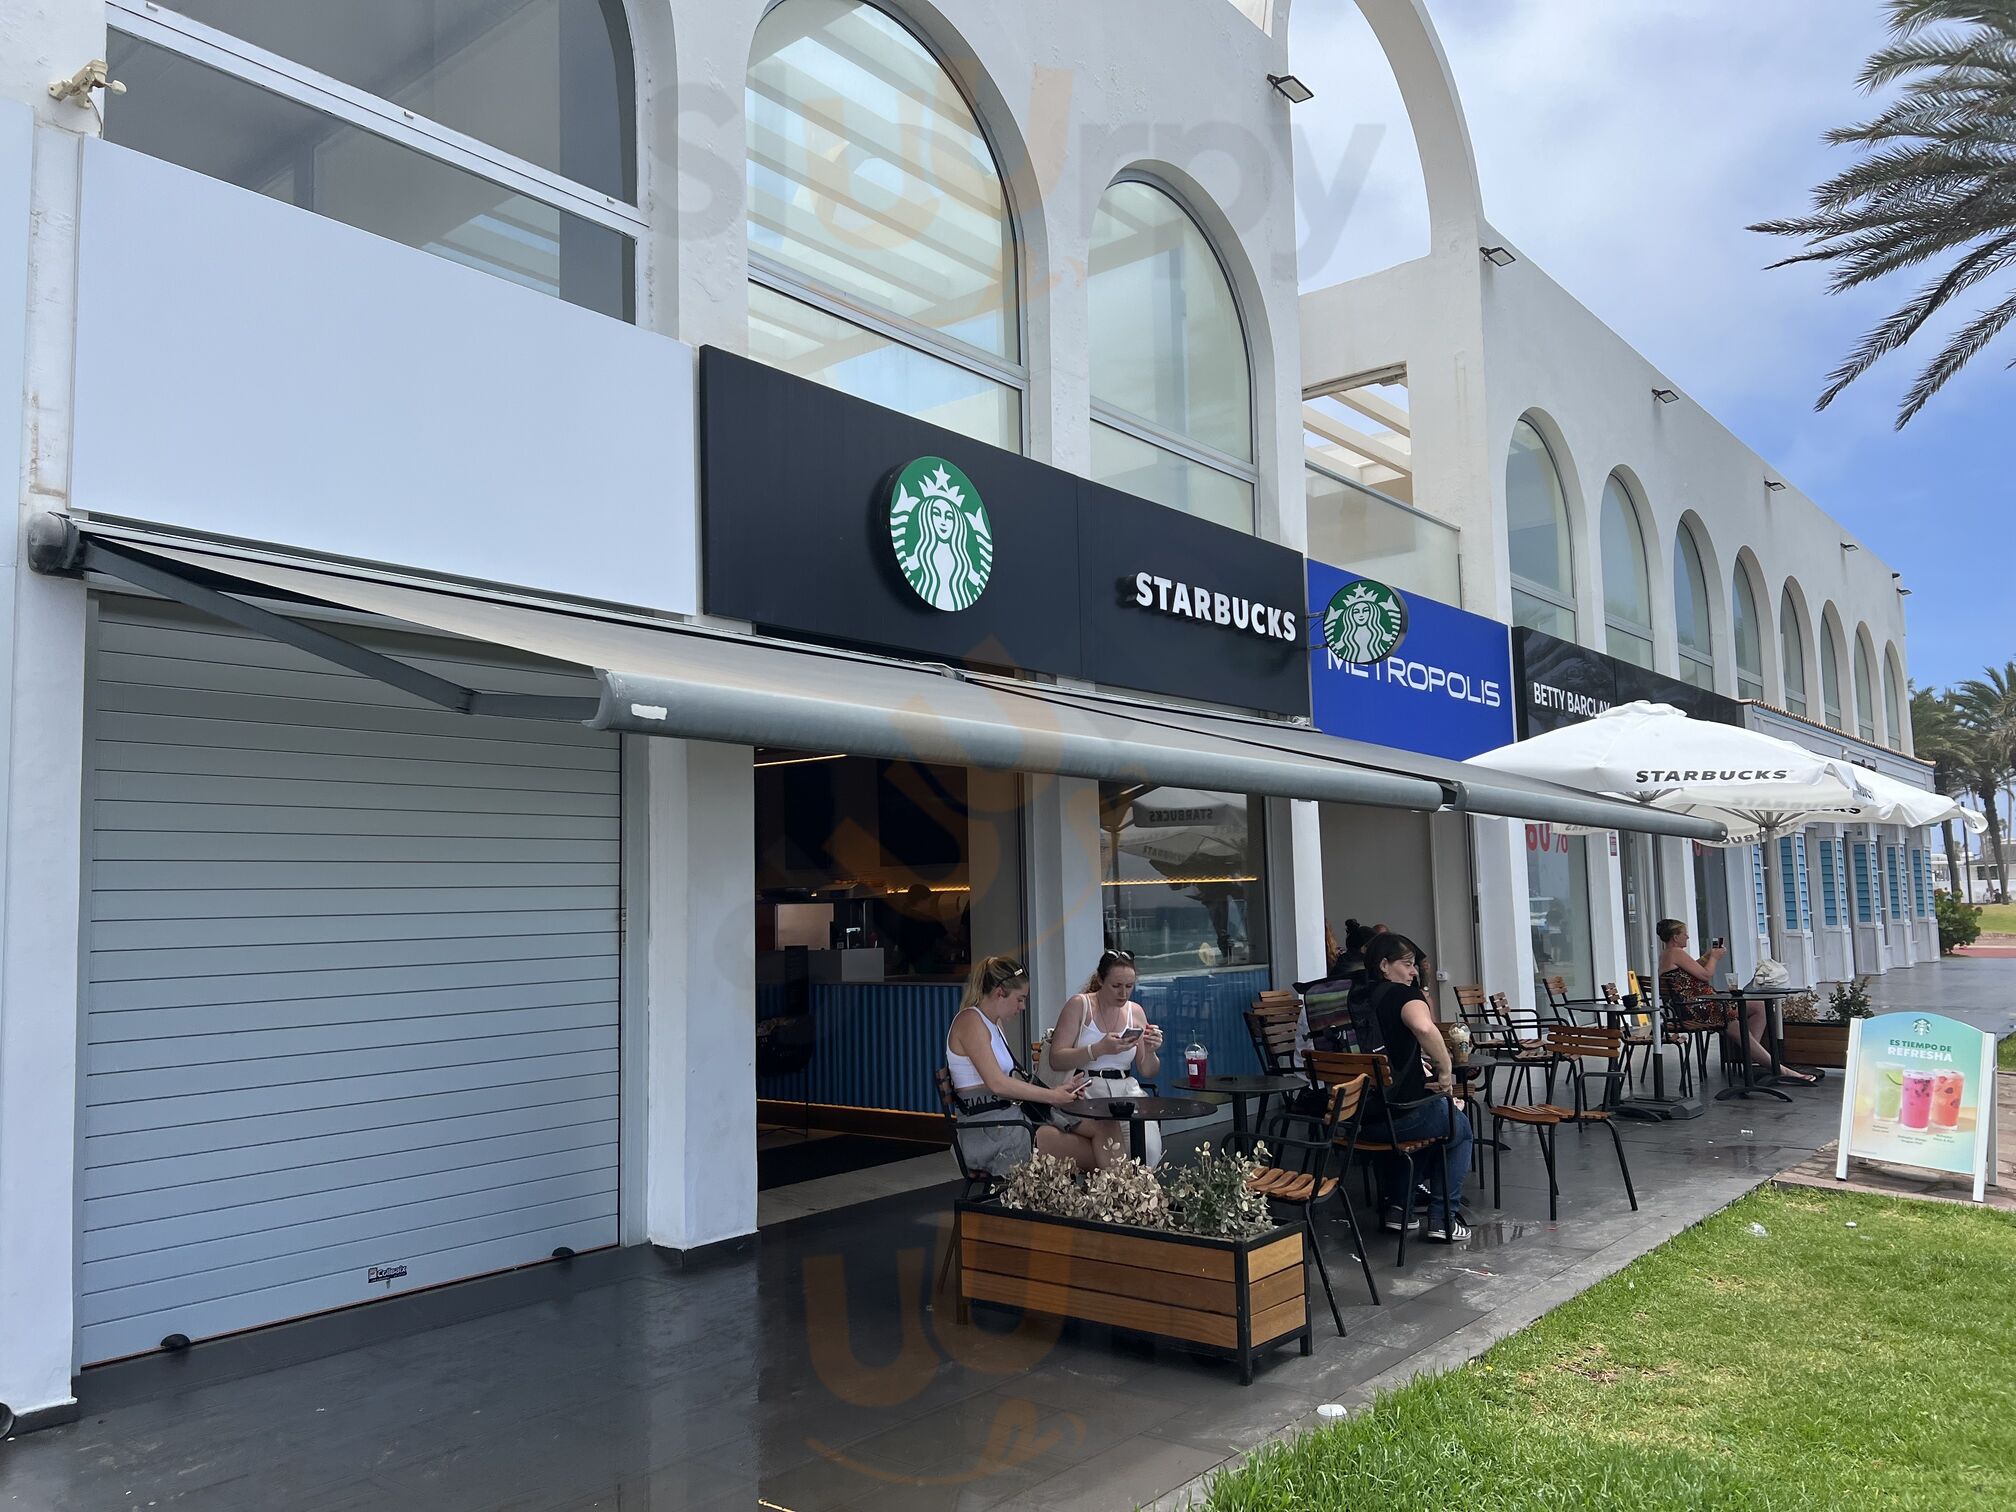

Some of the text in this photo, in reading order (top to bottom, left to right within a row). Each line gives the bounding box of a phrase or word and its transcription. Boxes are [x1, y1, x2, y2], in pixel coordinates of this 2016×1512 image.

[1136, 571, 1297, 642] STARBUCKS
[1533, 682, 1565, 710] BETTY
[1635, 770, 1787, 783] STARBUCKS
[1887, 1046, 1953, 1062] REFRESHA
[1902, 1040, 1938, 1051] TIEMPO
[1939, 1045, 1952, 1053] DE
